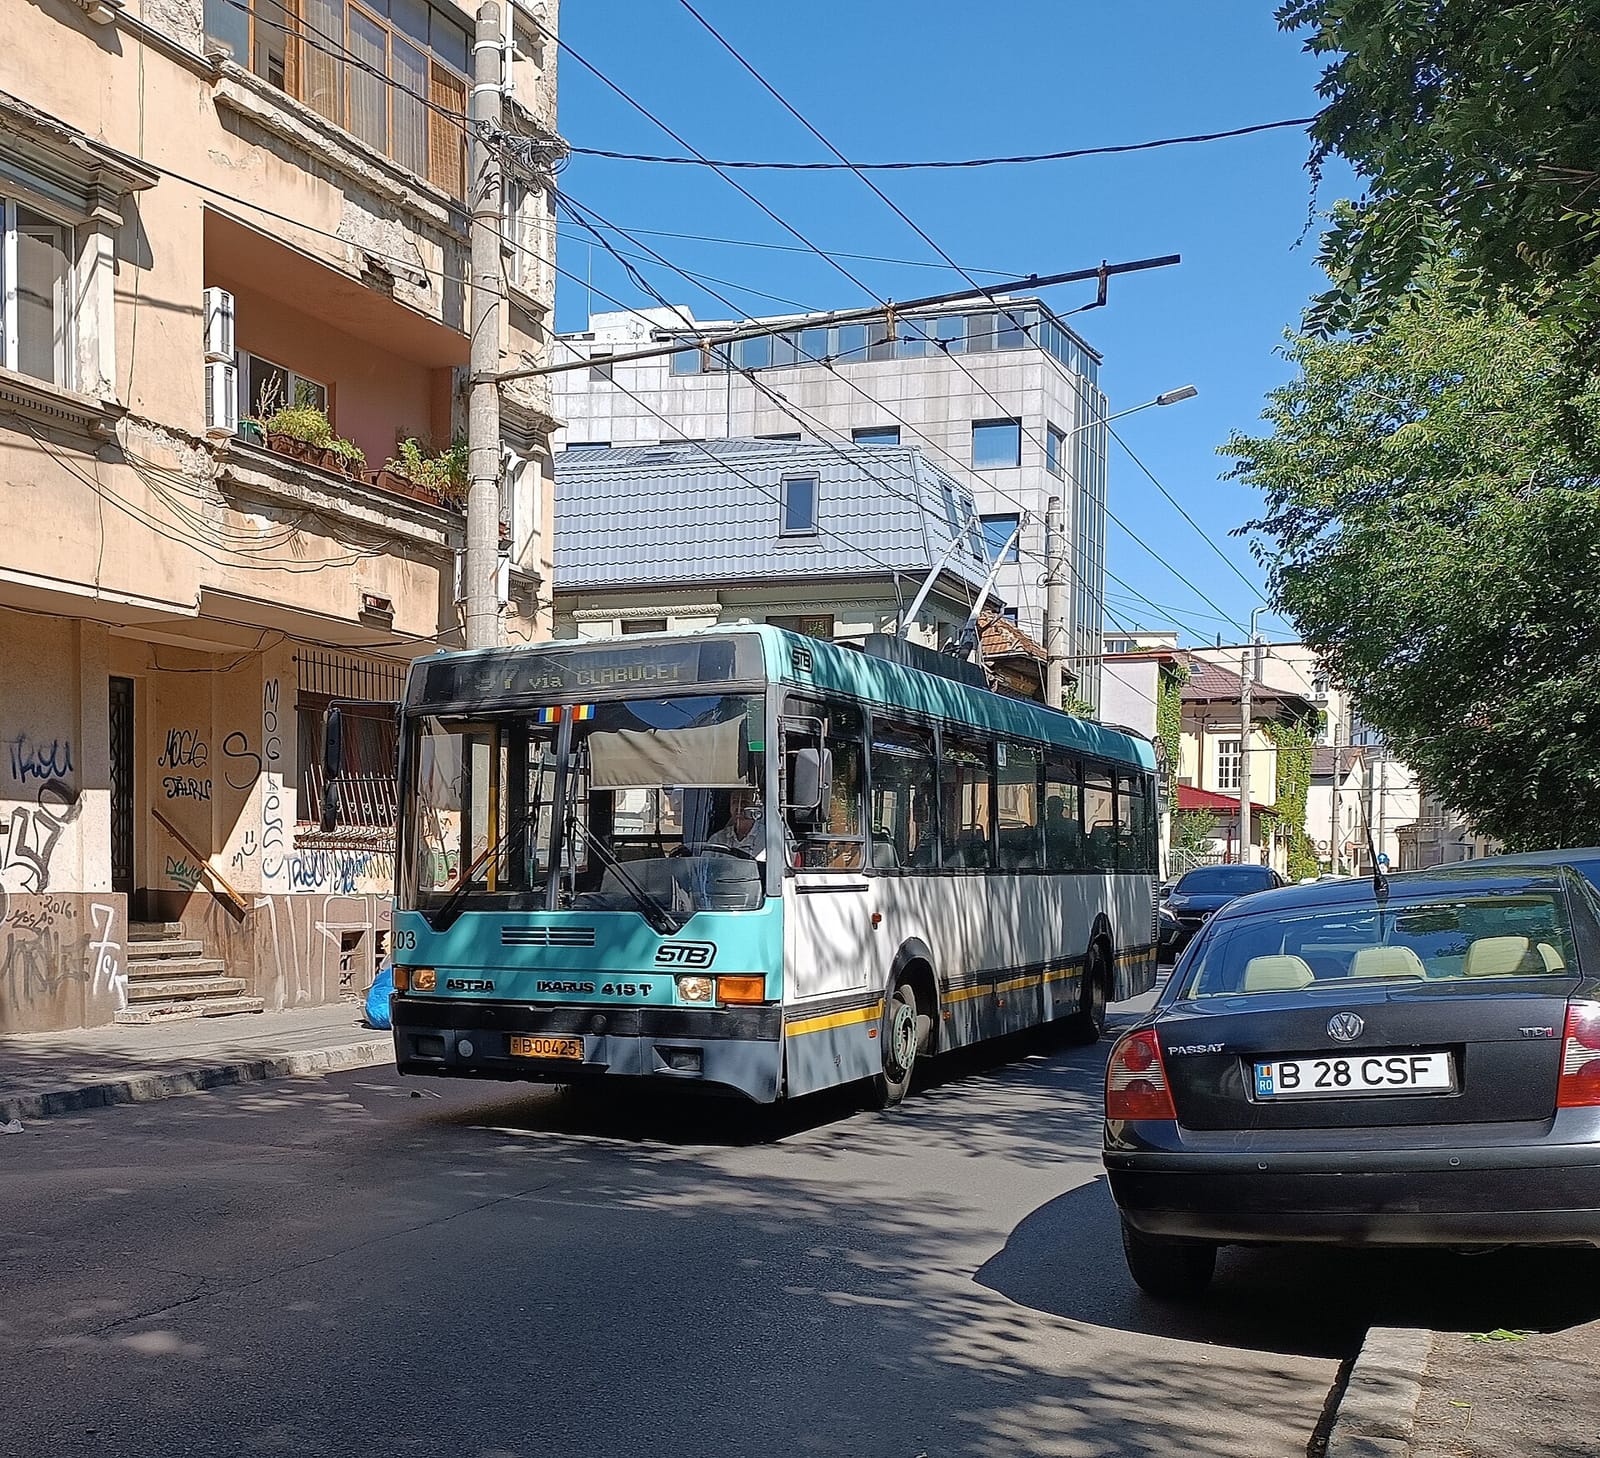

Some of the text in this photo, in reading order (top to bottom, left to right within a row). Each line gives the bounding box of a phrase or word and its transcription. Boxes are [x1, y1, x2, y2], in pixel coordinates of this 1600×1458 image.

[792, 649, 810, 669] STB
[528, 673, 563, 689] via
[655, 944, 711, 965] STB
[446, 979, 494, 992] ASTRA
[536, 981, 652, 996] IKARUS 415 T
[1518, 1027, 1553, 1037] TDI
[1168, 1043, 1225, 1056] PASSAT
[1279, 1057, 1432, 1089] B 28 CSF
[1259, 1080, 1272, 1091] RO
